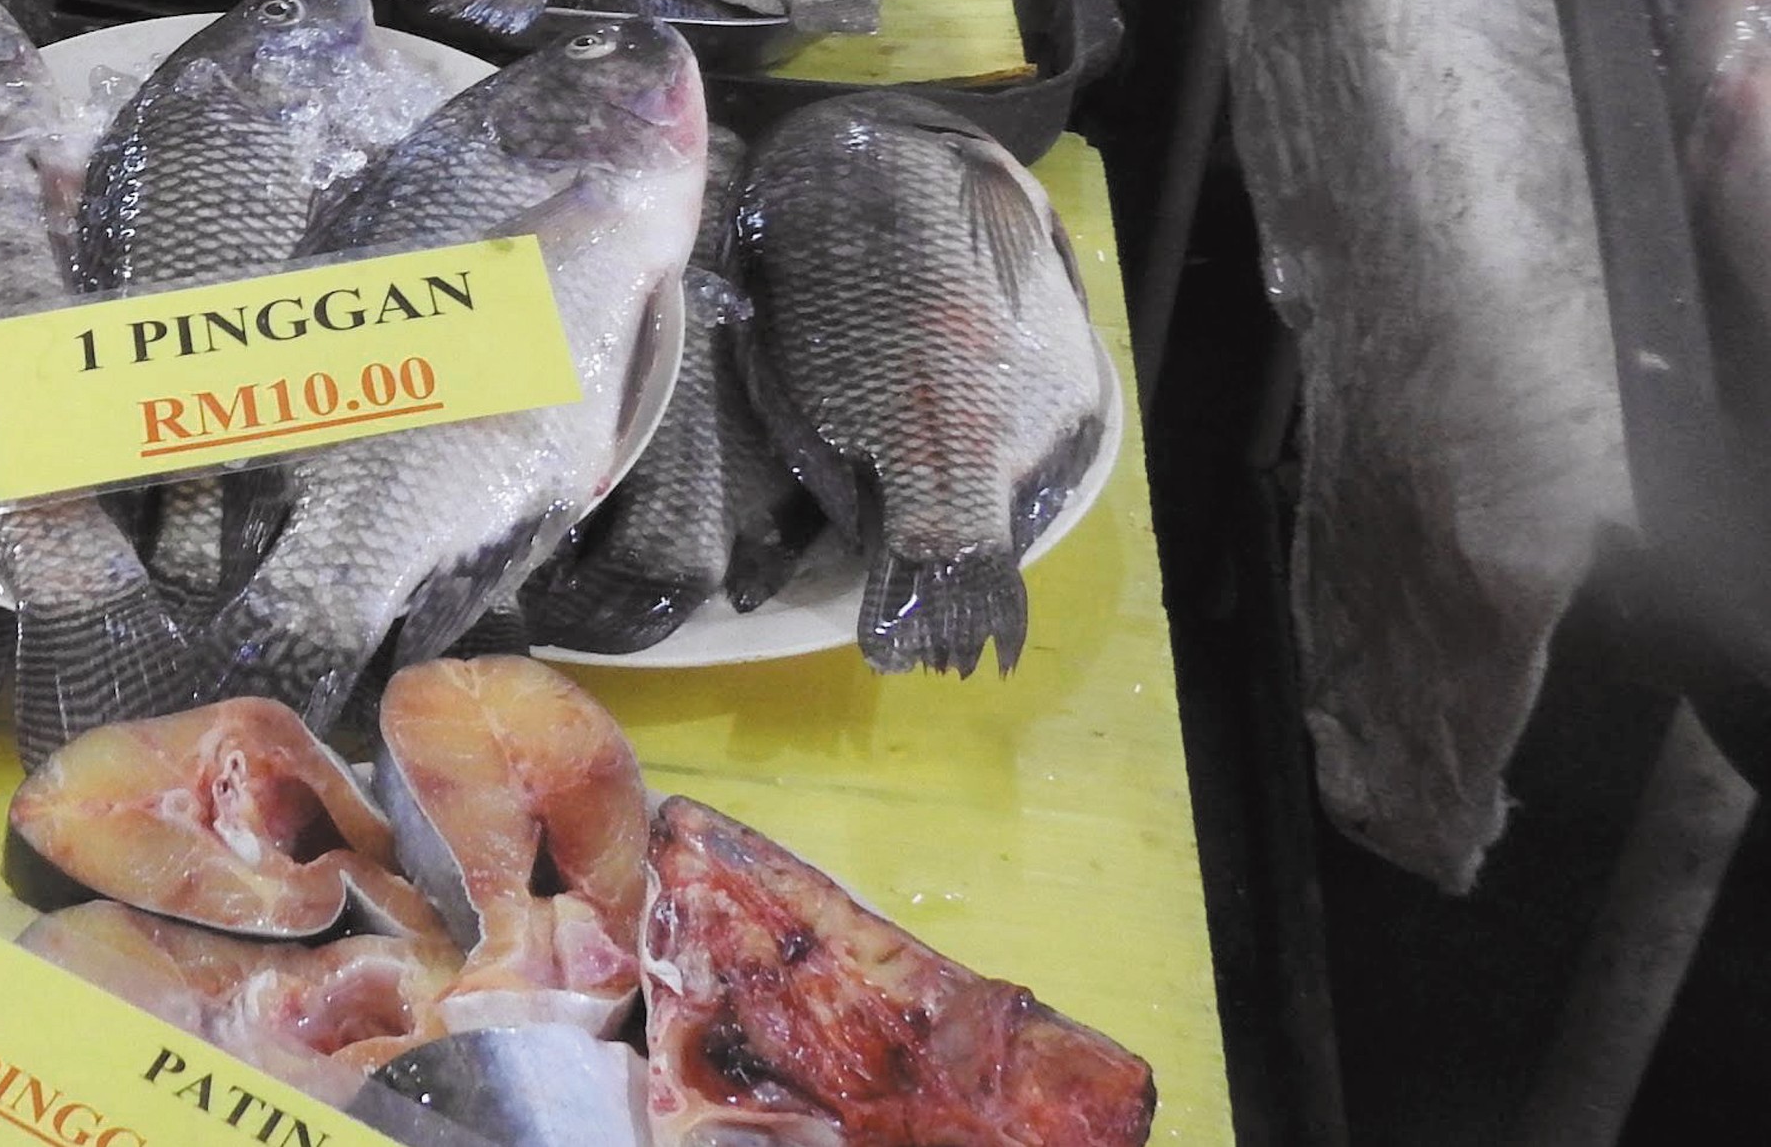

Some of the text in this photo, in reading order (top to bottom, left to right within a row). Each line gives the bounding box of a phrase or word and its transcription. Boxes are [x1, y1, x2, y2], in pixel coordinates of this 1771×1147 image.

[75, 271, 475, 372] 1 PINGGAN
[137, 356, 436, 445] RM10.00
[141, 1046, 331, 1147] PATIN
